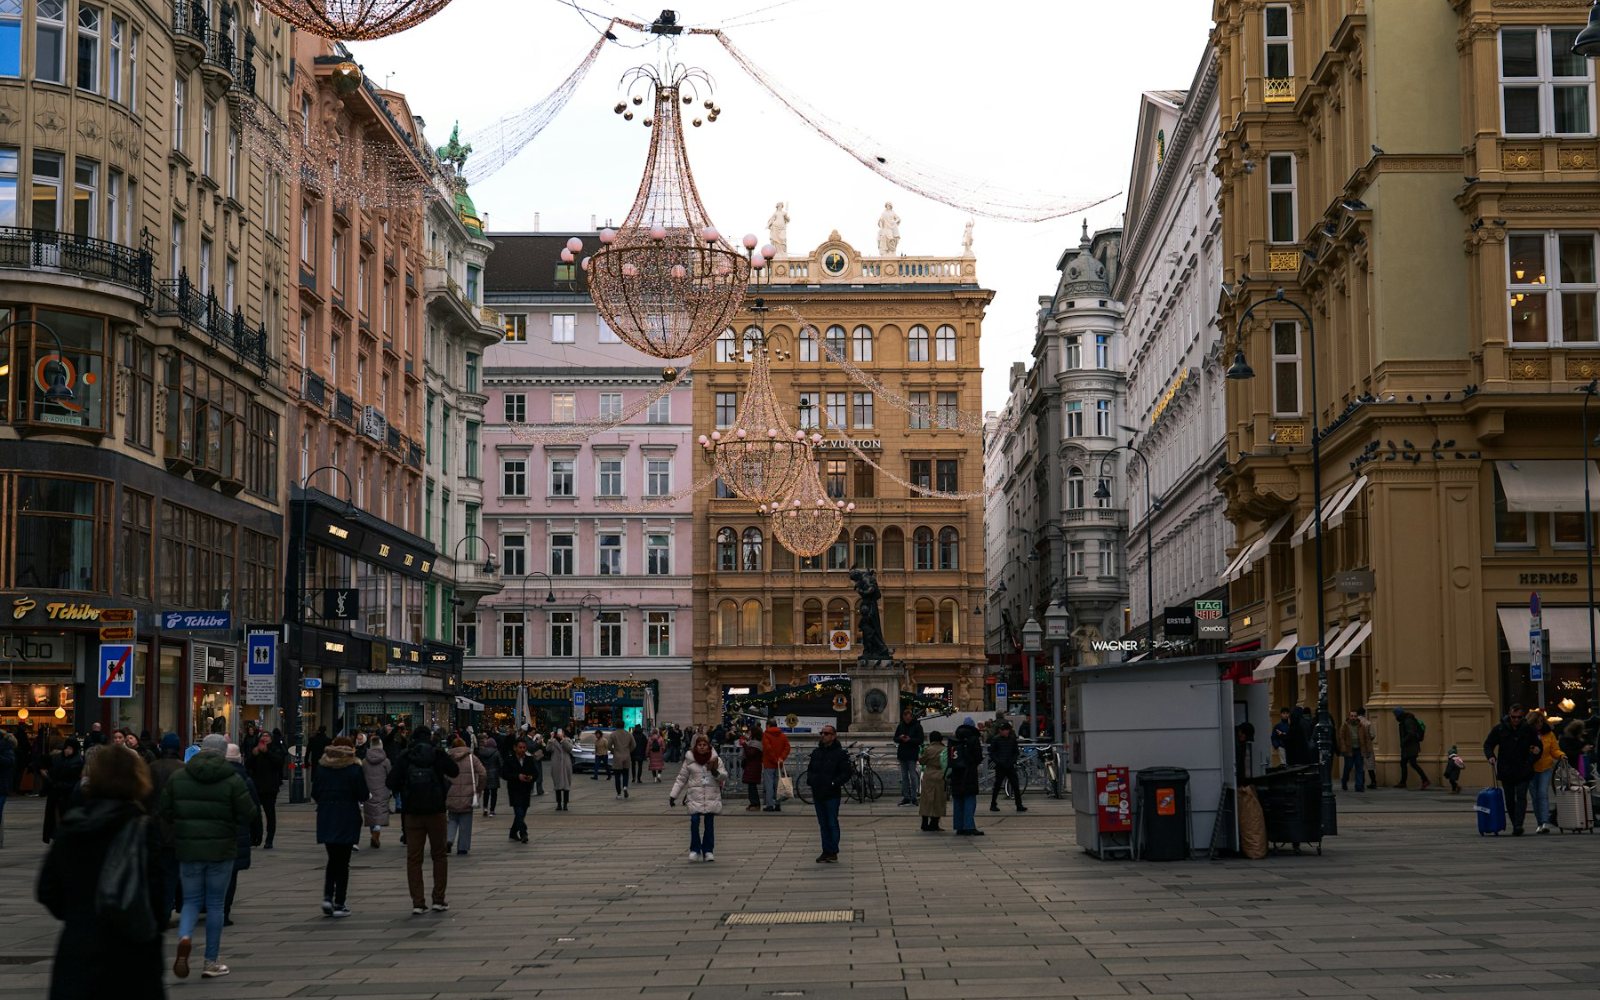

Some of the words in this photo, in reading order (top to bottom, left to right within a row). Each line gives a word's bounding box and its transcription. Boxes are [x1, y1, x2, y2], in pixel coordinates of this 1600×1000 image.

[46, 602, 101, 620] Tchibo
[184, 615, 228, 627] Tchibo
[3, 635, 53, 661] Qbo
[1091, 640, 1138, 650] WAGNER
[479, 686, 519, 700] Juliu
[529, 686, 570, 700] Meinl
